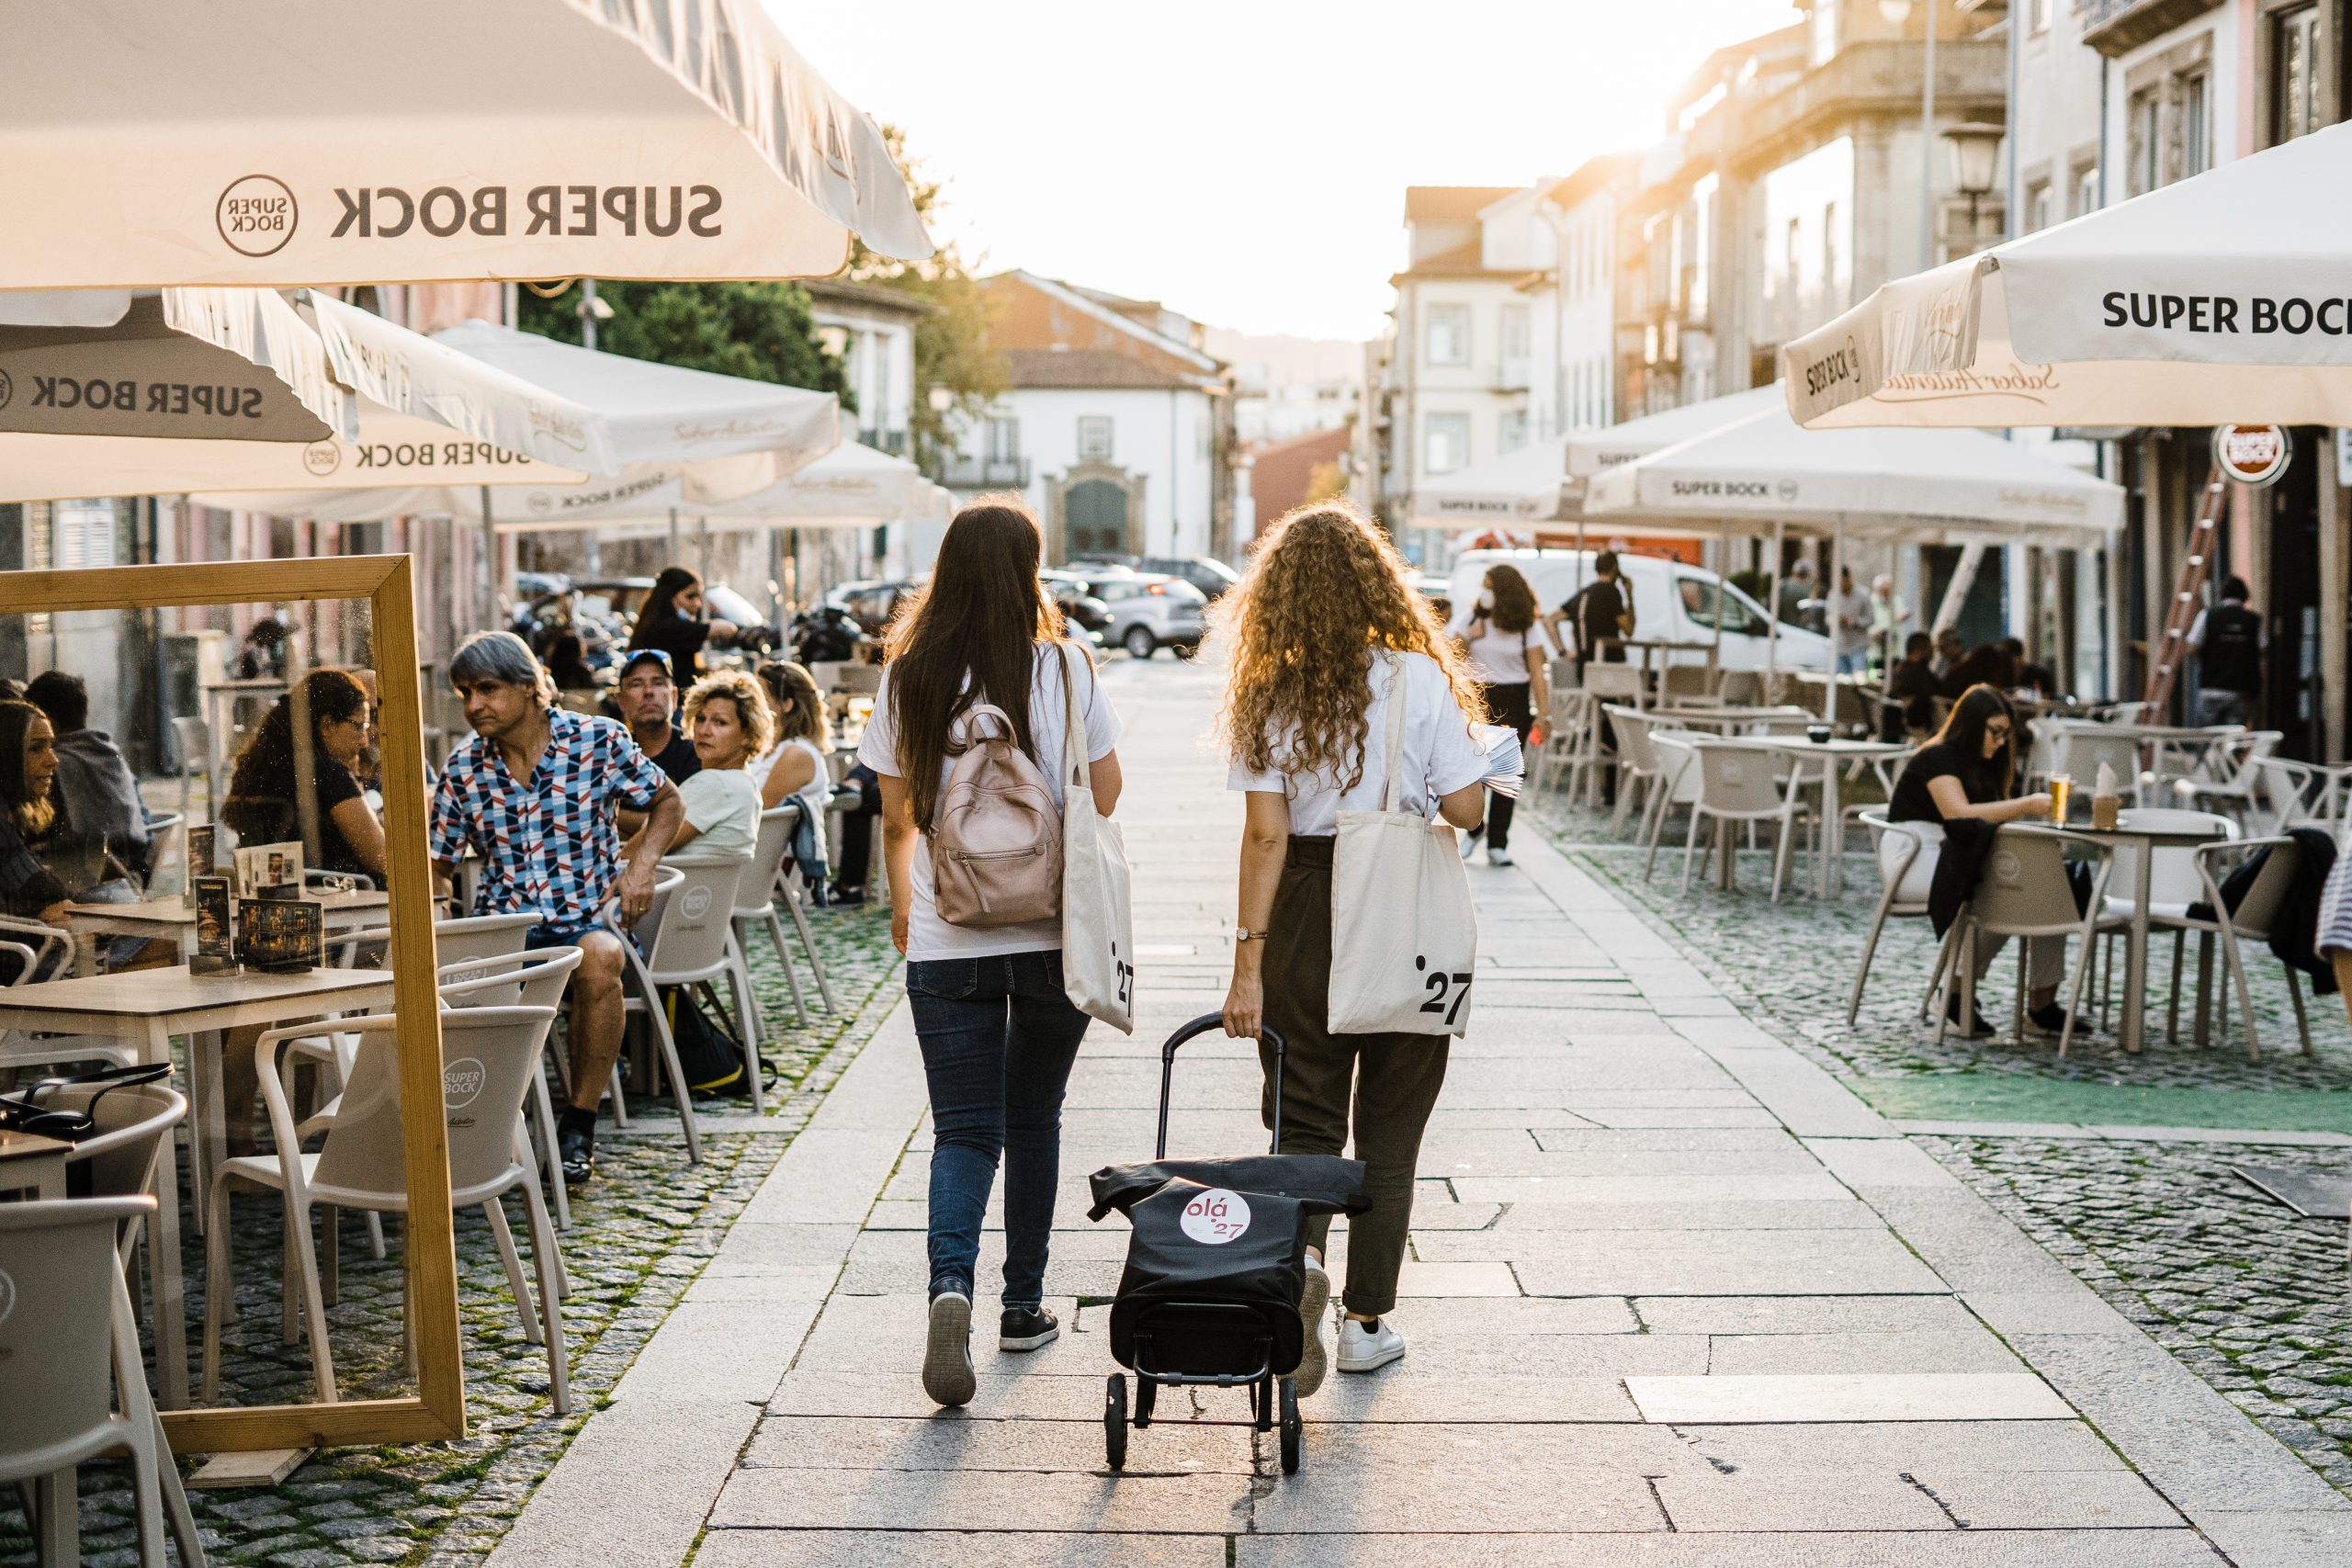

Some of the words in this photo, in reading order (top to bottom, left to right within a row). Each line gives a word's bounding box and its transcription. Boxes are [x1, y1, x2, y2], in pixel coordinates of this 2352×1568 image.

[2102, 291, 2240, 333] SUPER
[1672, 481, 1721, 496] SUPER
[1725, 481, 1769, 496] BOCK
[445, 1072, 481, 1083] SUPER
[445, 1082, 477, 1094] BOCK
[1186, 1197, 1227, 1217] olá
